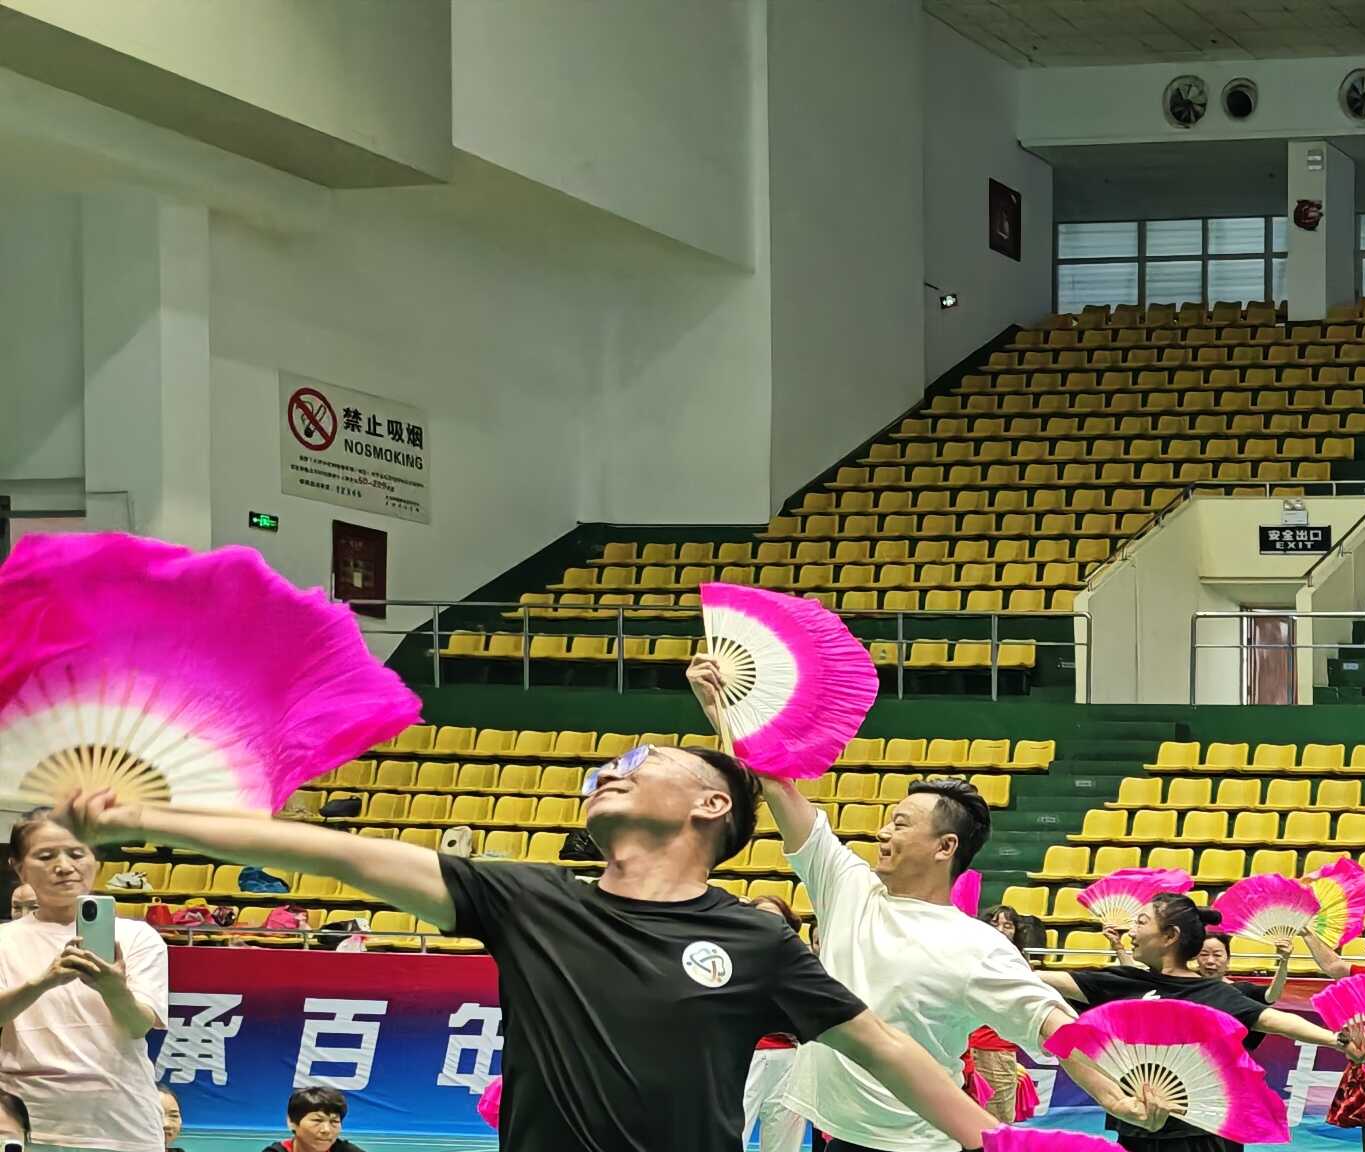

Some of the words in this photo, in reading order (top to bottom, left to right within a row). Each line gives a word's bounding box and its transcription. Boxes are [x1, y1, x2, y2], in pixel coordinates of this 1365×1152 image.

[343, 407, 424, 450] 禁止吸烟
[344, 438, 424, 471] NOSMOKING
[1268, 530, 1322, 541] 安全出口
[1275, 541, 1315, 549] EXIT
